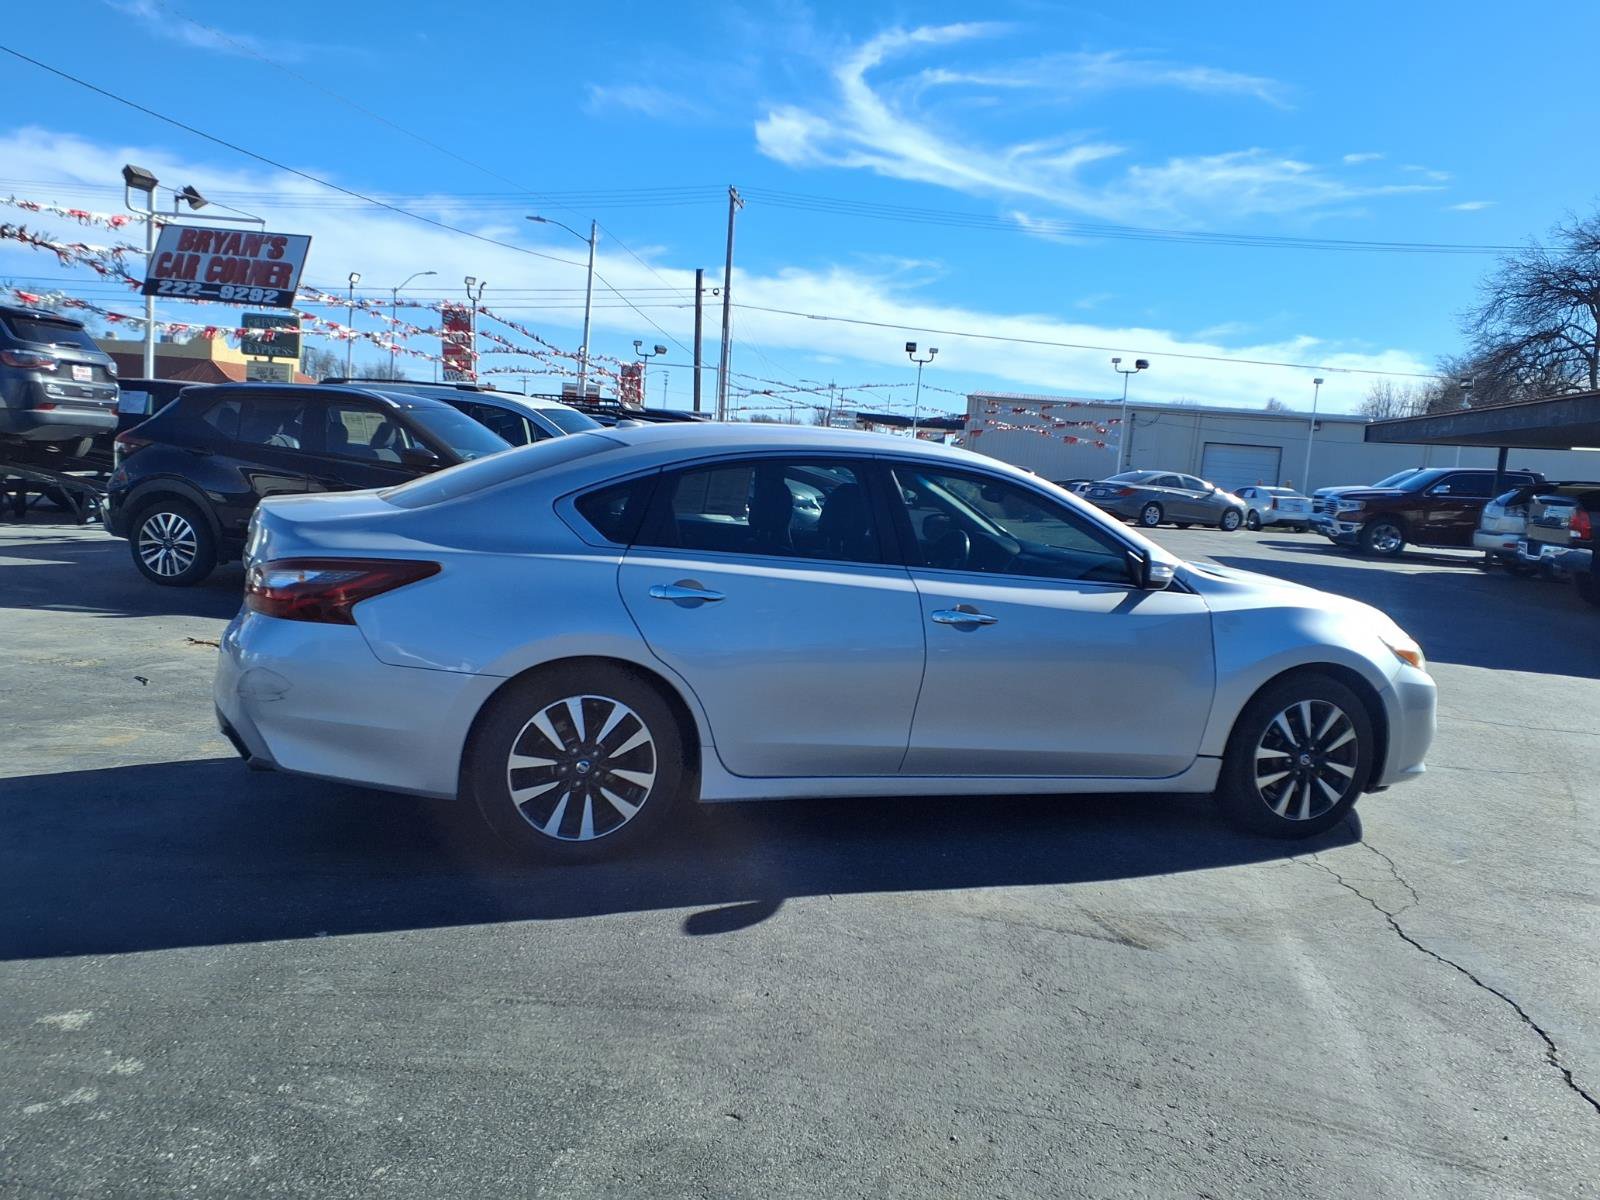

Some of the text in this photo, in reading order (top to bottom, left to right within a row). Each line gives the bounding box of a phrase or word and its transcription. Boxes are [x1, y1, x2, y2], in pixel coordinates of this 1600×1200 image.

[177, 228, 288, 260] BRYAN'S
[155, 252, 294, 290] CAR CORNER
